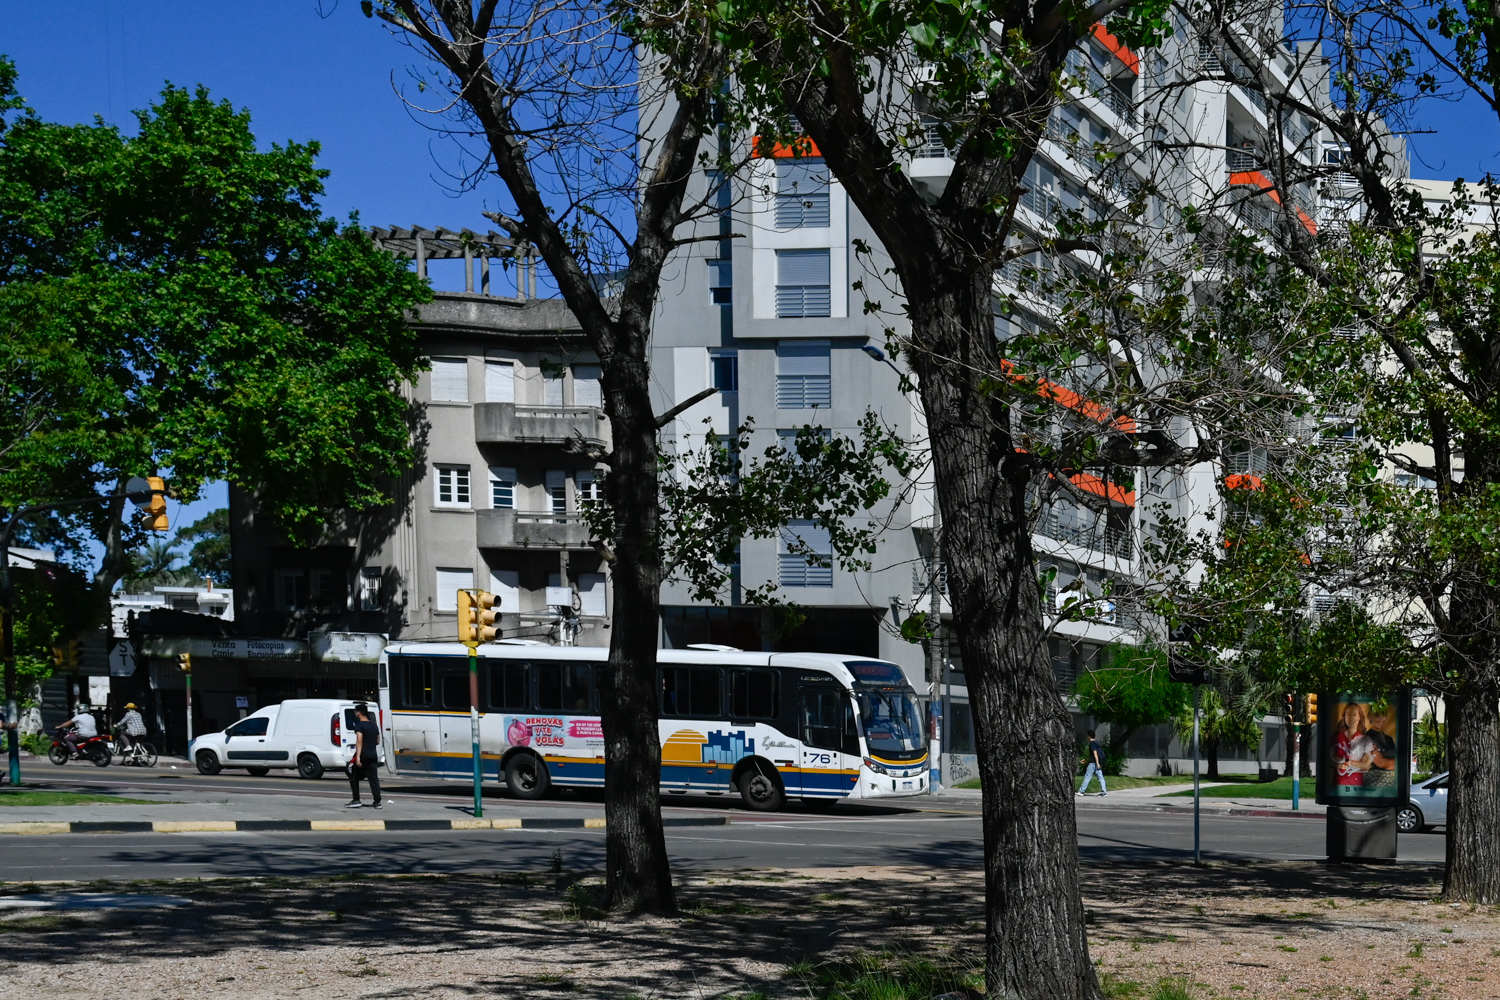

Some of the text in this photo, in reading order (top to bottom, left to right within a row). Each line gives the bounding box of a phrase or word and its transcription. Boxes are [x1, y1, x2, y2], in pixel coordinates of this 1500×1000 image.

[211, 640, 285, 651] Venta Fotocopias
[534, 727, 552, 736] Y TE
[808, 753, 831, 764] 76
